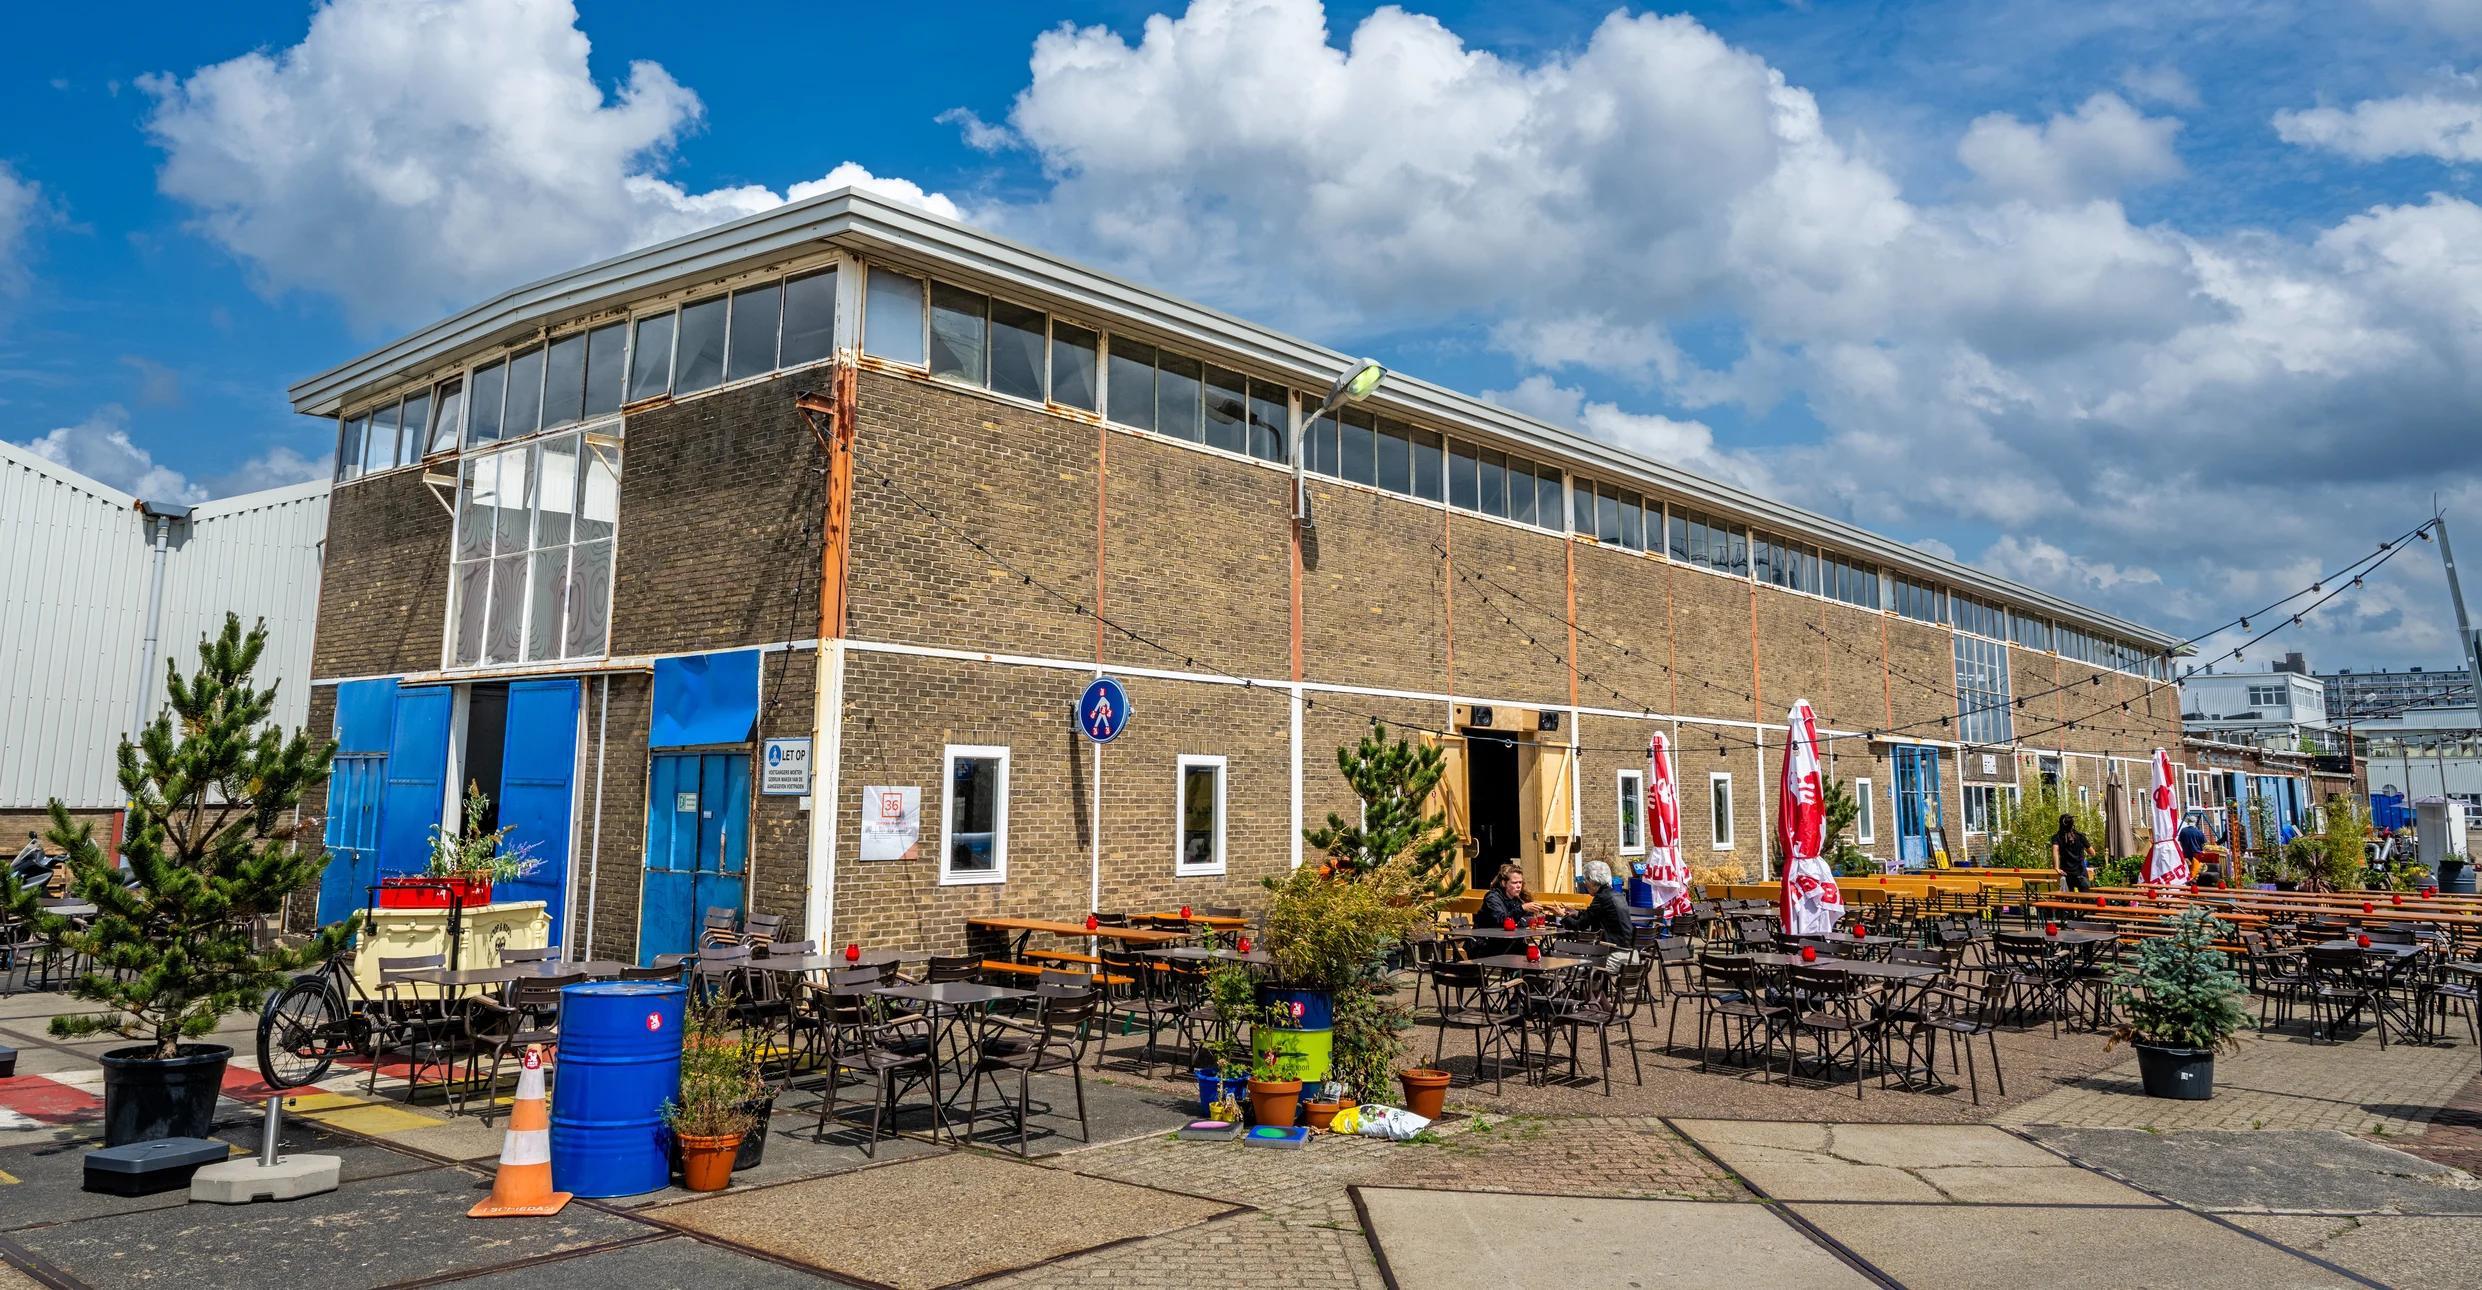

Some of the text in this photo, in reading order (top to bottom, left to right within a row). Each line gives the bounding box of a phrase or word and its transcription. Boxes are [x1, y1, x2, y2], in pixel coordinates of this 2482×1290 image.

[782, 750, 806, 761] LET OP
[885, 800, 898, 810] 36
